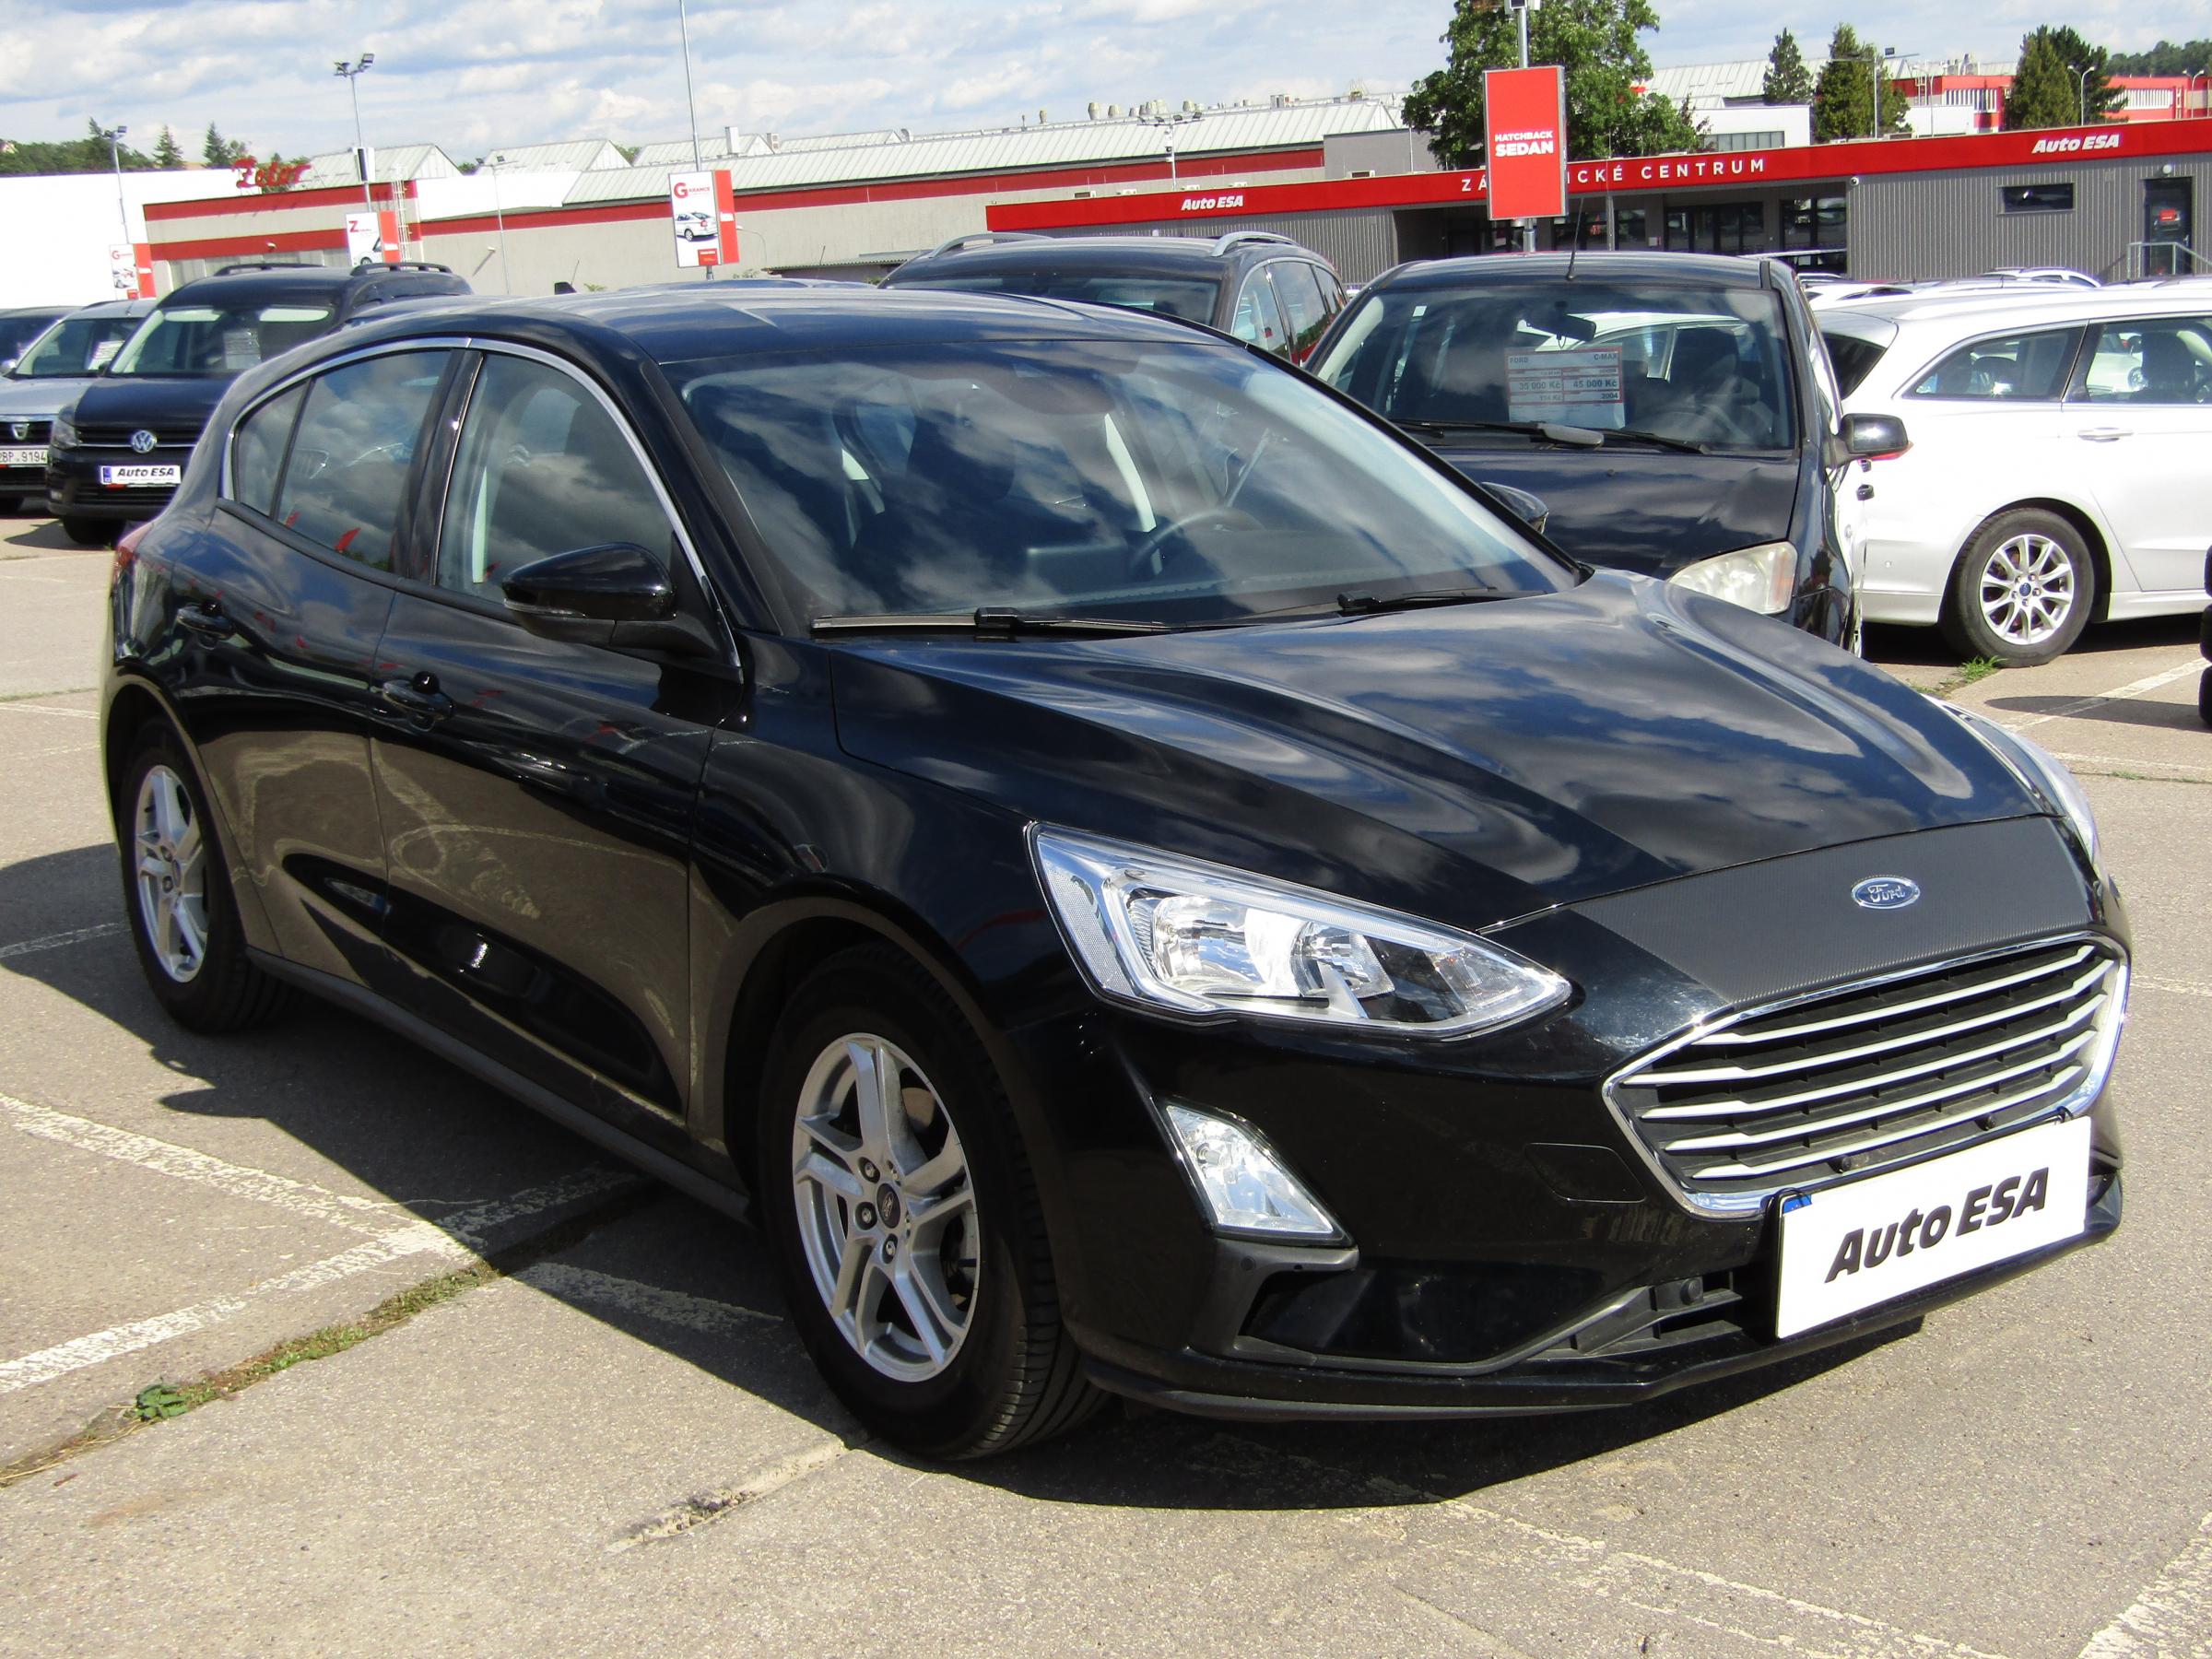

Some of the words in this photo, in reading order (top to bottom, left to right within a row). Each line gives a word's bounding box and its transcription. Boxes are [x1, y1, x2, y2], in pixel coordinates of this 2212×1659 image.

[1494, 130, 1553, 142] HATCHBACK
[2031, 138, 2081, 154] Auto
[2082, 134, 2120, 150] ESA
[1495, 141, 1554, 157] SEDAN
[231, 155, 312, 188] Zetor
[1641, 159, 1764, 180] CENTRUM
[1181, 197, 1216, 210] Auto
[1217, 194, 1243, 208] ESA
[1531, 382, 1547, 390] 000
[1572, 380, 1584, 388] 45
[1586, 379, 1603, 387] 000
[1605, 378, 1618, 387] Kč
[117, 467, 148, 477] Auto
[150, 467, 175, 477] ESA
[1867, 884, 1906, 902] Ford
[1824, 1205, 1952, 1284] Auto
[1955, 1167, 2050, 1237] ESA
